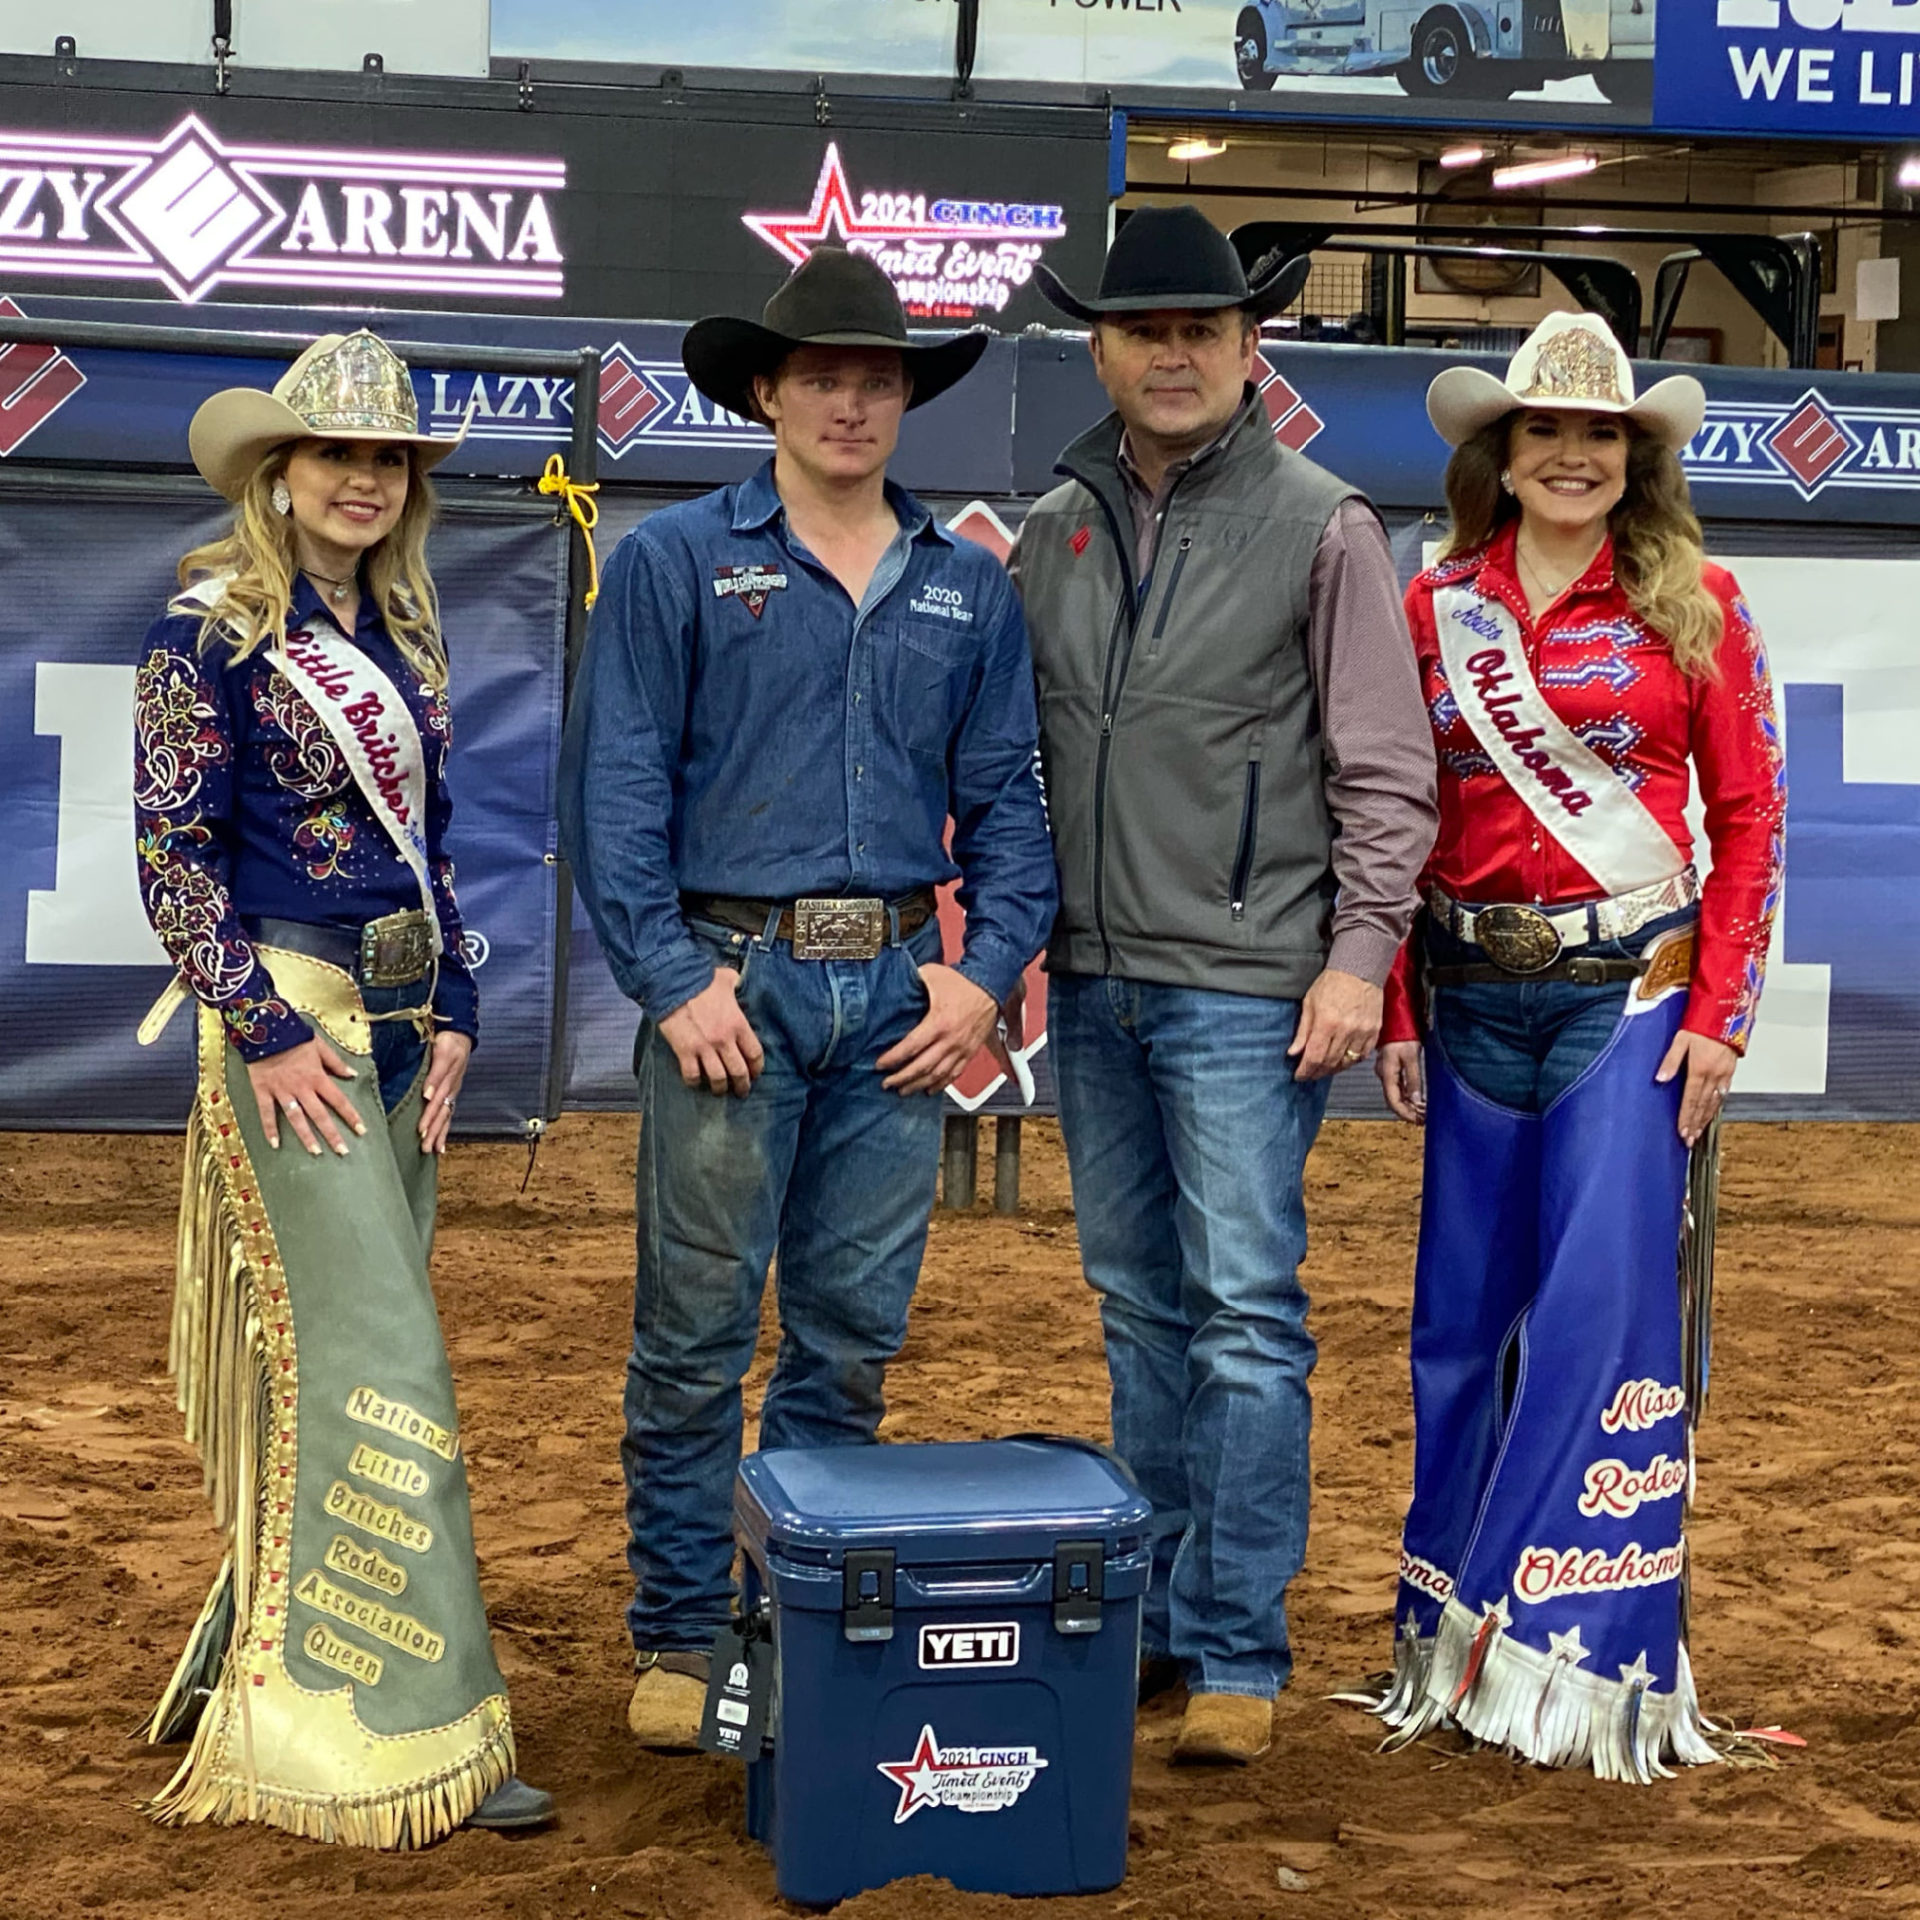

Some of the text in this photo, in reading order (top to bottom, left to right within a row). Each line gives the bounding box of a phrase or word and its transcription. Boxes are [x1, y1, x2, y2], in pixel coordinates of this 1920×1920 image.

[1728, 46, 1920, 105] WE LI
[280, 183, 564, 262] ARENA
[861, 193, 1062, 228] 2021 CINCH
[945, 241, 1041, 284] Event
[431, 374, 564, 418] LAZY
[910, 599, 950, 618] National
[923, 585, 962, 605] 2020
[1466, 649, 1592, 817] Oklahoma
[341, 691, 411, 826] Britches
[353, 1389, 458, 1458] National
[1606, 1383, 1677, 1426] Miss
[355, 1448, 422, 1491] Little
[1584, 1462, 1683, 1512] Rodeo
[330, 1487, 427, 1547] Britches
[332, 1541, 401, 1588] Rodeo
[301, 1576, 439, 1658] Association
[310, 1628, 378, 1679] Queen
[927, 1631, 1010, 1660] YETI
[719, 1727, 741, 1741] YETI
[932, 1770, 1030, 1789] Timed Event
[940, 1752, 1028, 1766] 2021 CINCH
[943, 1789, 1013, 1803] Championship
